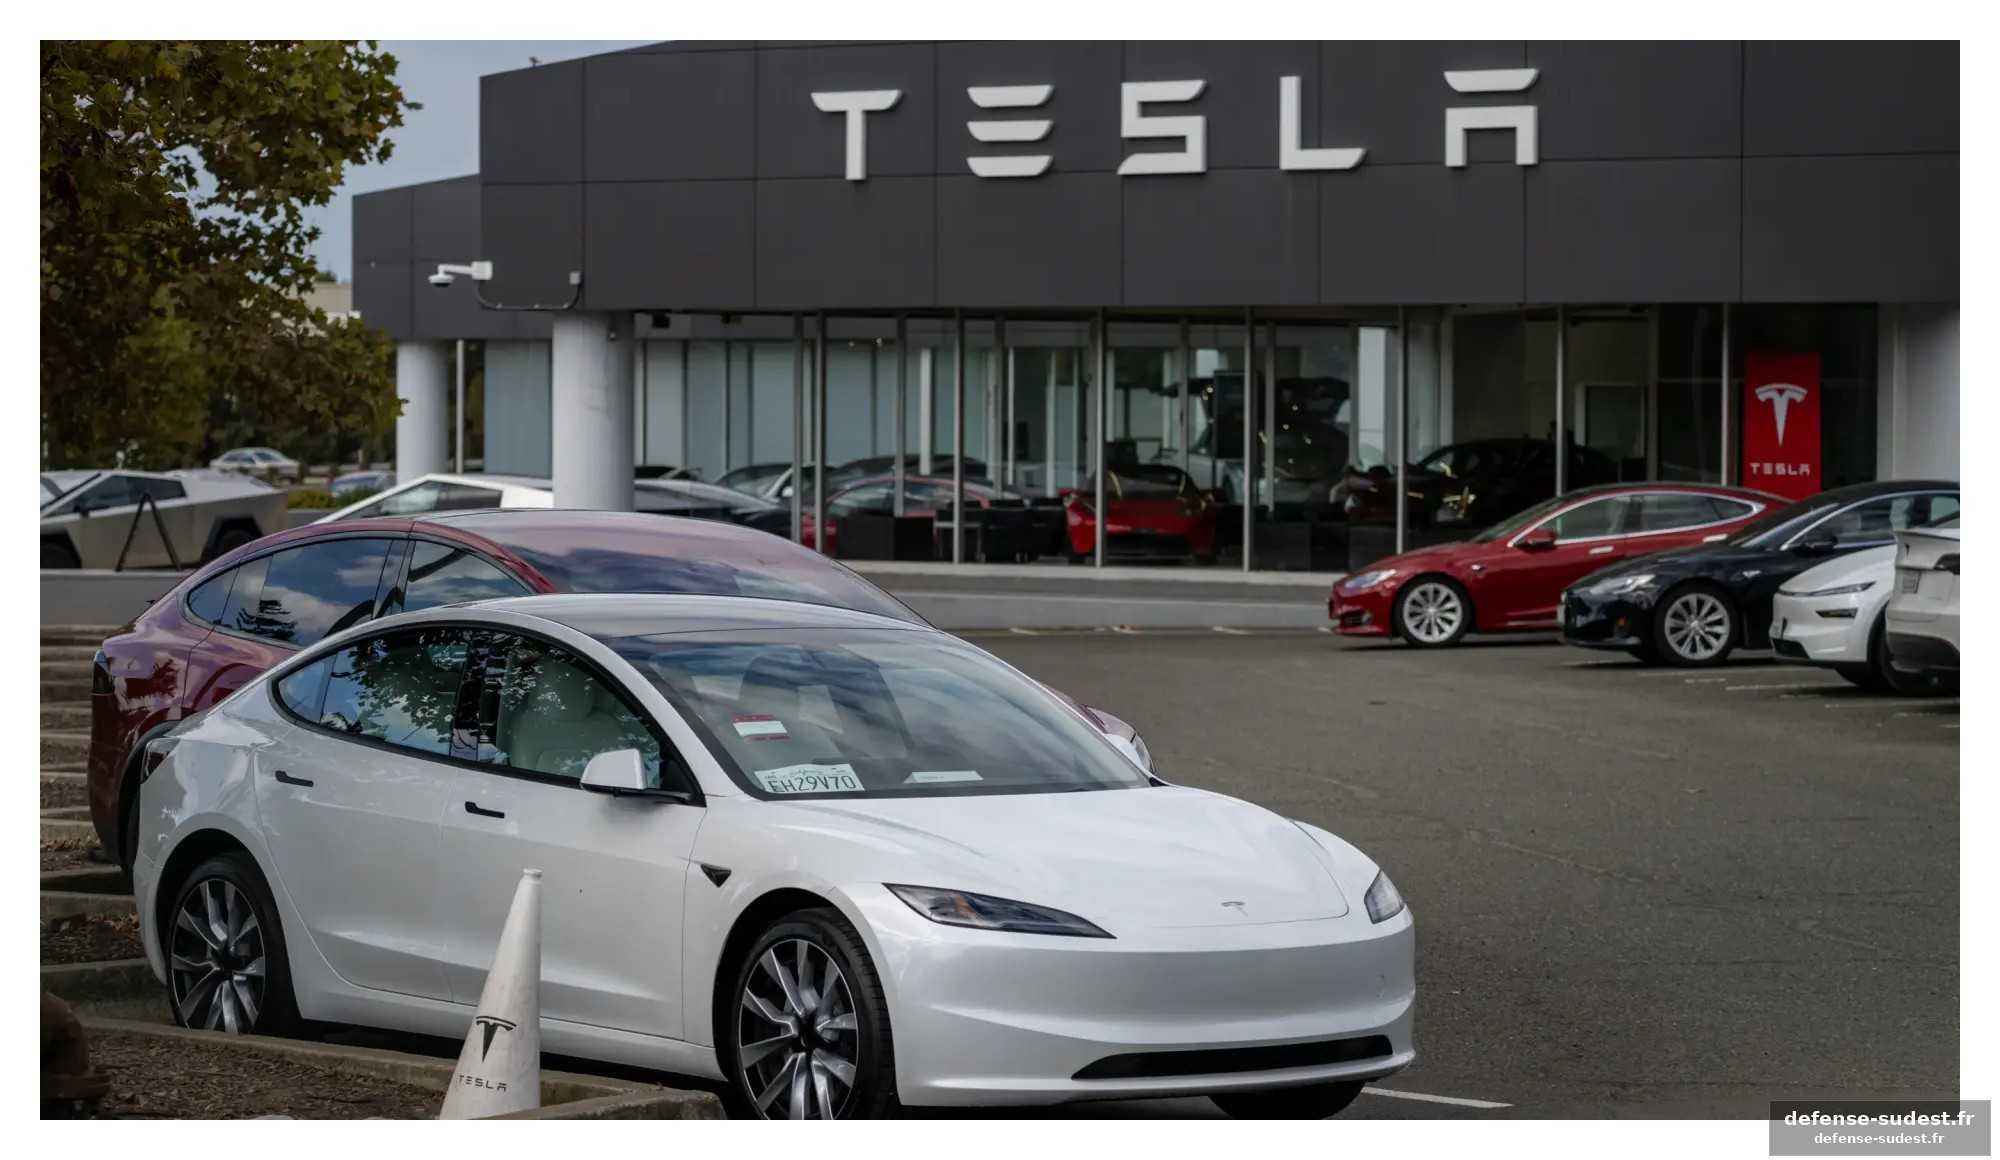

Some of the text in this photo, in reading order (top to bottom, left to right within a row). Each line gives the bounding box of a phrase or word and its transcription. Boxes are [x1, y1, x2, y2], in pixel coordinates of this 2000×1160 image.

[811, 68, 1538, 180] TESLA
[1750, 462, 1811, 476] TESLA
[457, 1074, 507, 1092] TESLA
